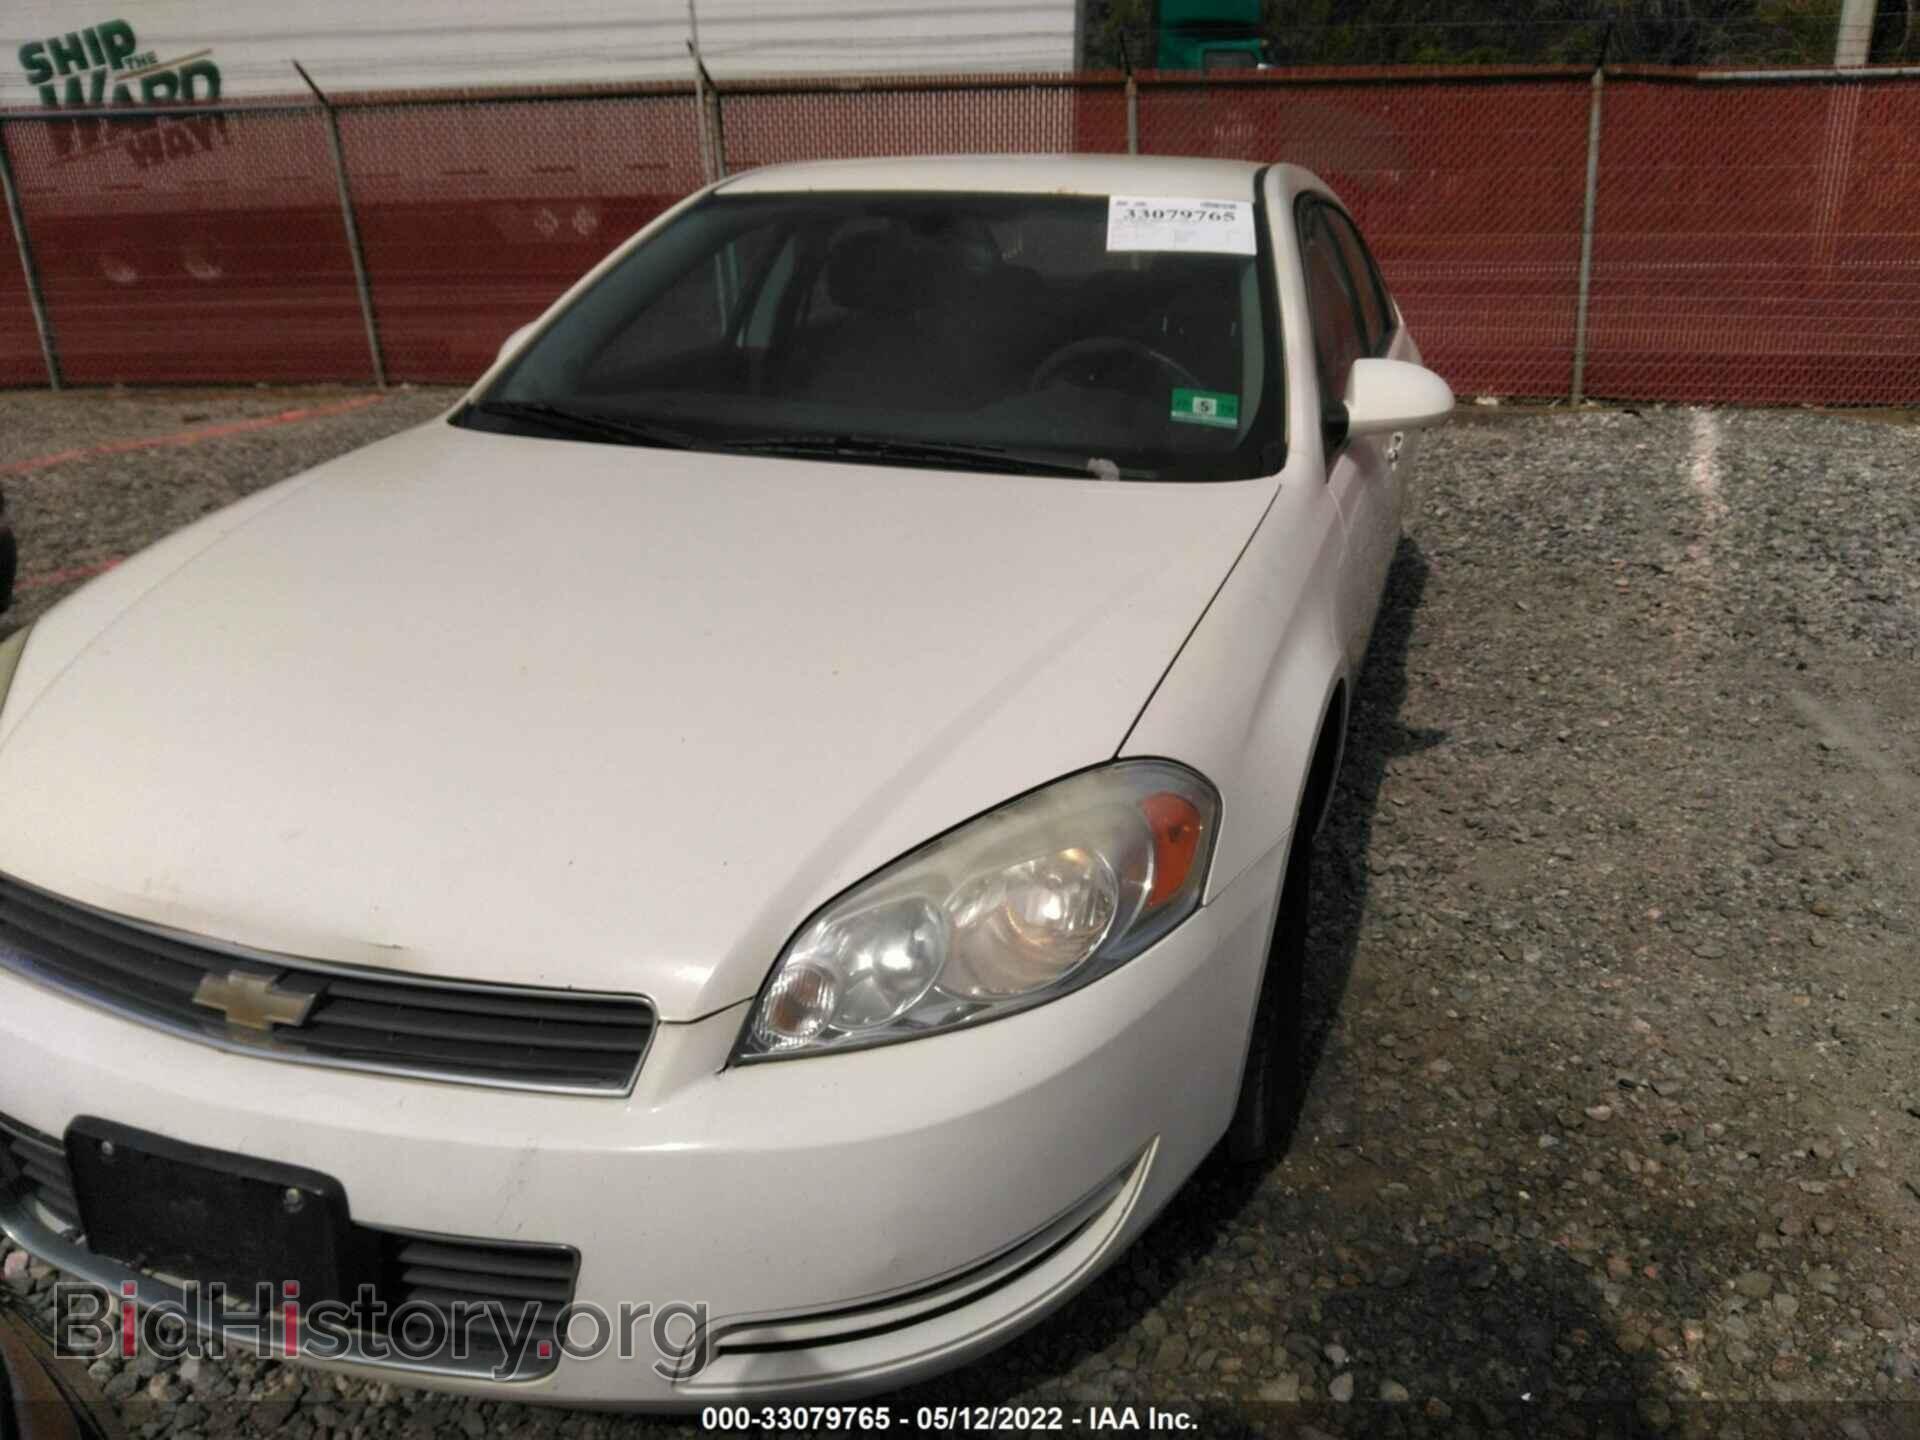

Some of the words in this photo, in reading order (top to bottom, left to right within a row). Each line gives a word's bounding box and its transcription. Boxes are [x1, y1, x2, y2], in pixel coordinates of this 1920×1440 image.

[18, 18, 137, 85] SHIP
[123, 50, 159, 70] THE
[38, 59, 222, 158] WARD
[1123, 208, 1237, 223] 33079765
